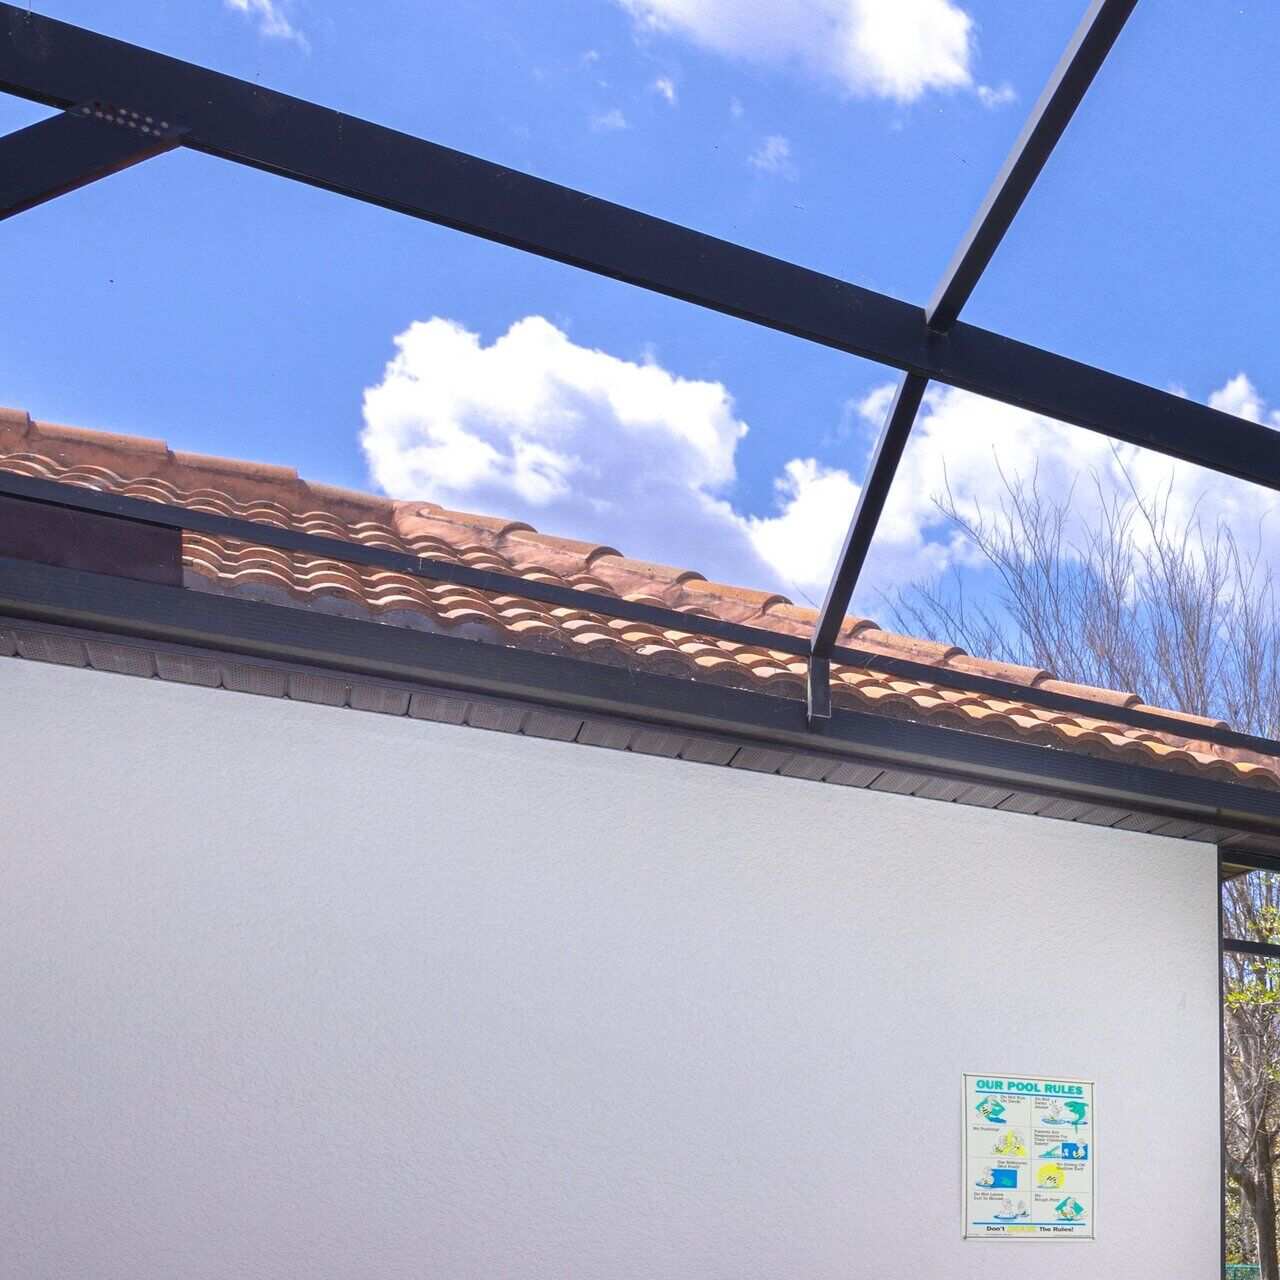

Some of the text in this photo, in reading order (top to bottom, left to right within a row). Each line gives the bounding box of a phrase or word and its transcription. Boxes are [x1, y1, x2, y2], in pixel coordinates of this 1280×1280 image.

[976, 1079, 1083, 1095] OUR POOL RULES
